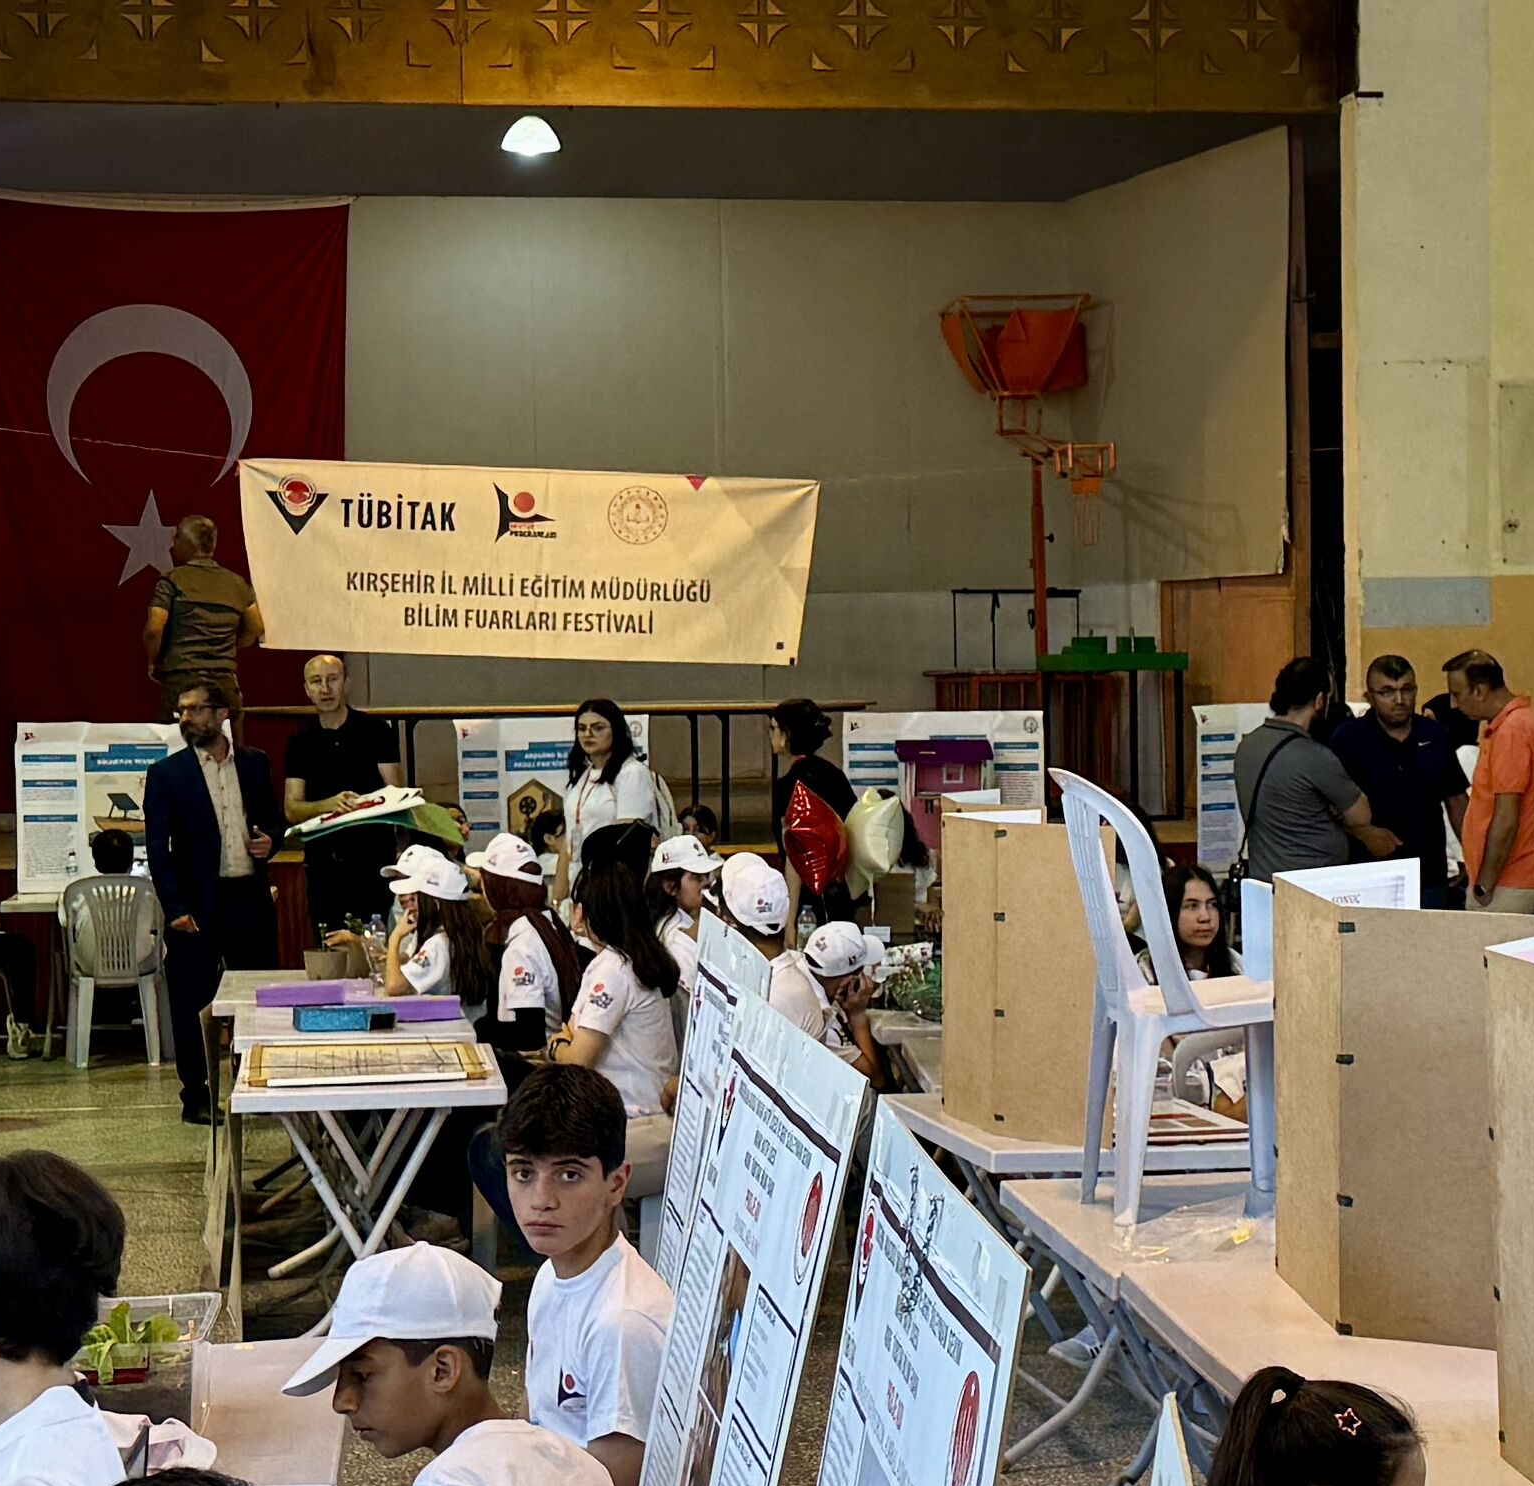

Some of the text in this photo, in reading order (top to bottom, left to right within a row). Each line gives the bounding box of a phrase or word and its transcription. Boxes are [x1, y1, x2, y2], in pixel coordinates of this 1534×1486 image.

[340, 492, 456, 531] TÜBİTAK
[346, 570, 711, 603] KIRŞEHİR İL MİLLİ EĞİTİM MÜDÜRLÜĞÜ
[404, 602, 654, 635] BİLİM FUARLARI FESTİVALİ
